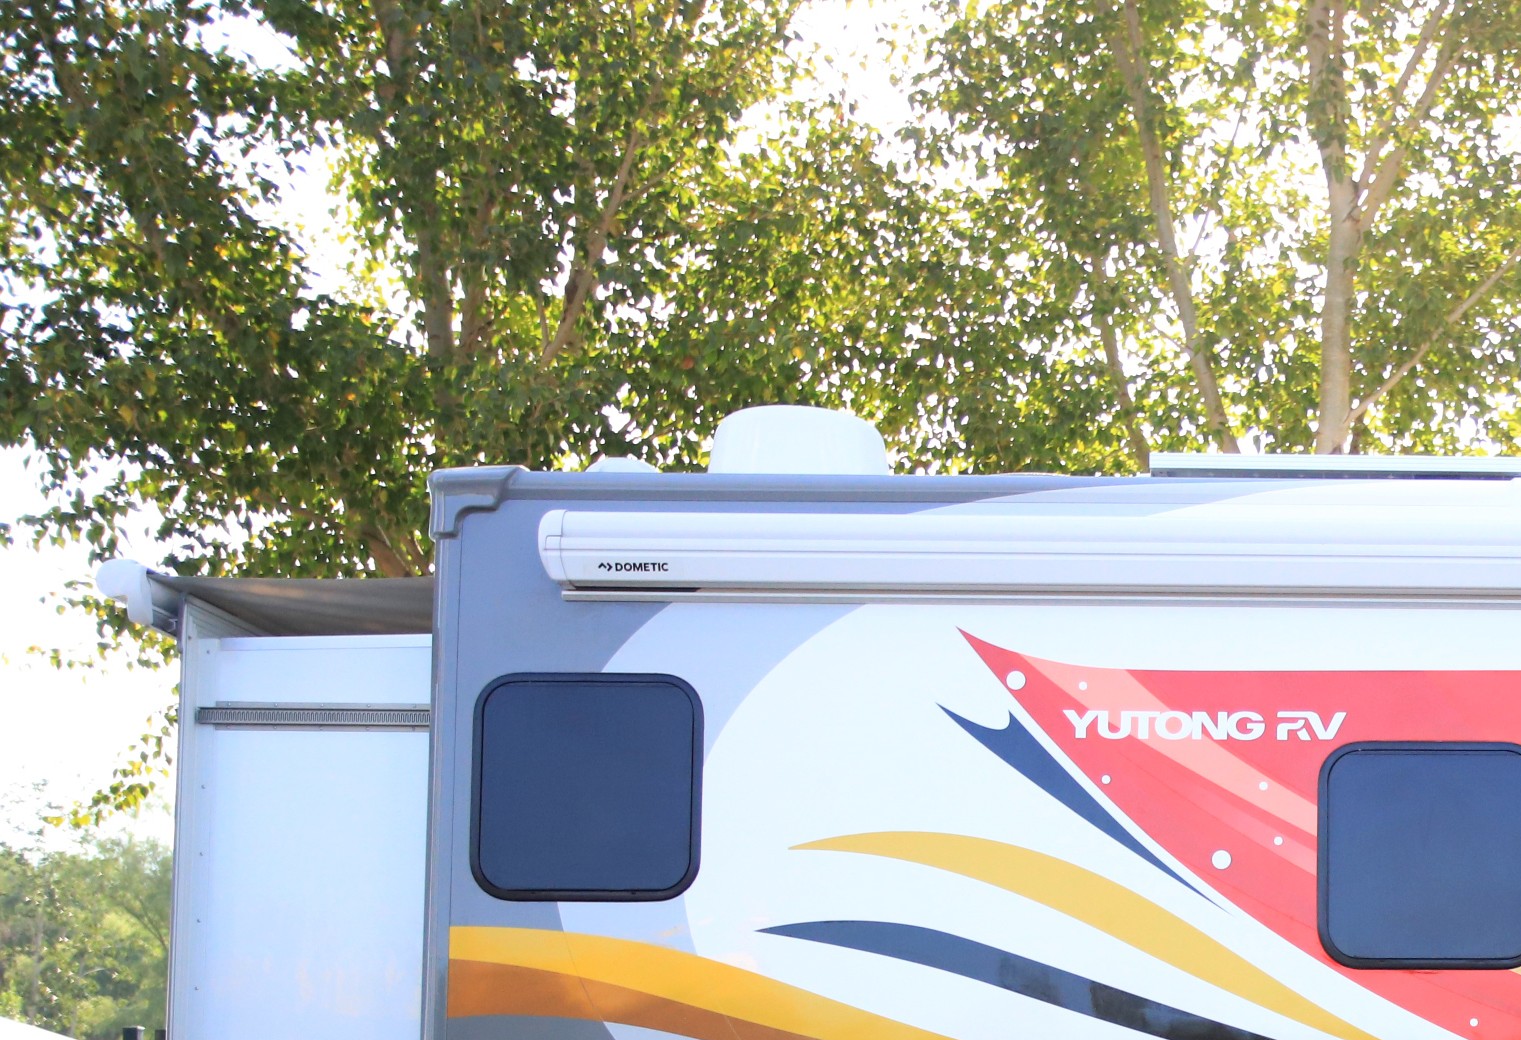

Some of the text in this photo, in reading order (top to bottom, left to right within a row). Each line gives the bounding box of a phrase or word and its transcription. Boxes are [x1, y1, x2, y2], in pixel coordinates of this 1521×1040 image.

[615, 562, 669, 572] DOMETIC
[1062, 709, 1347, 741] YUTONG RV
